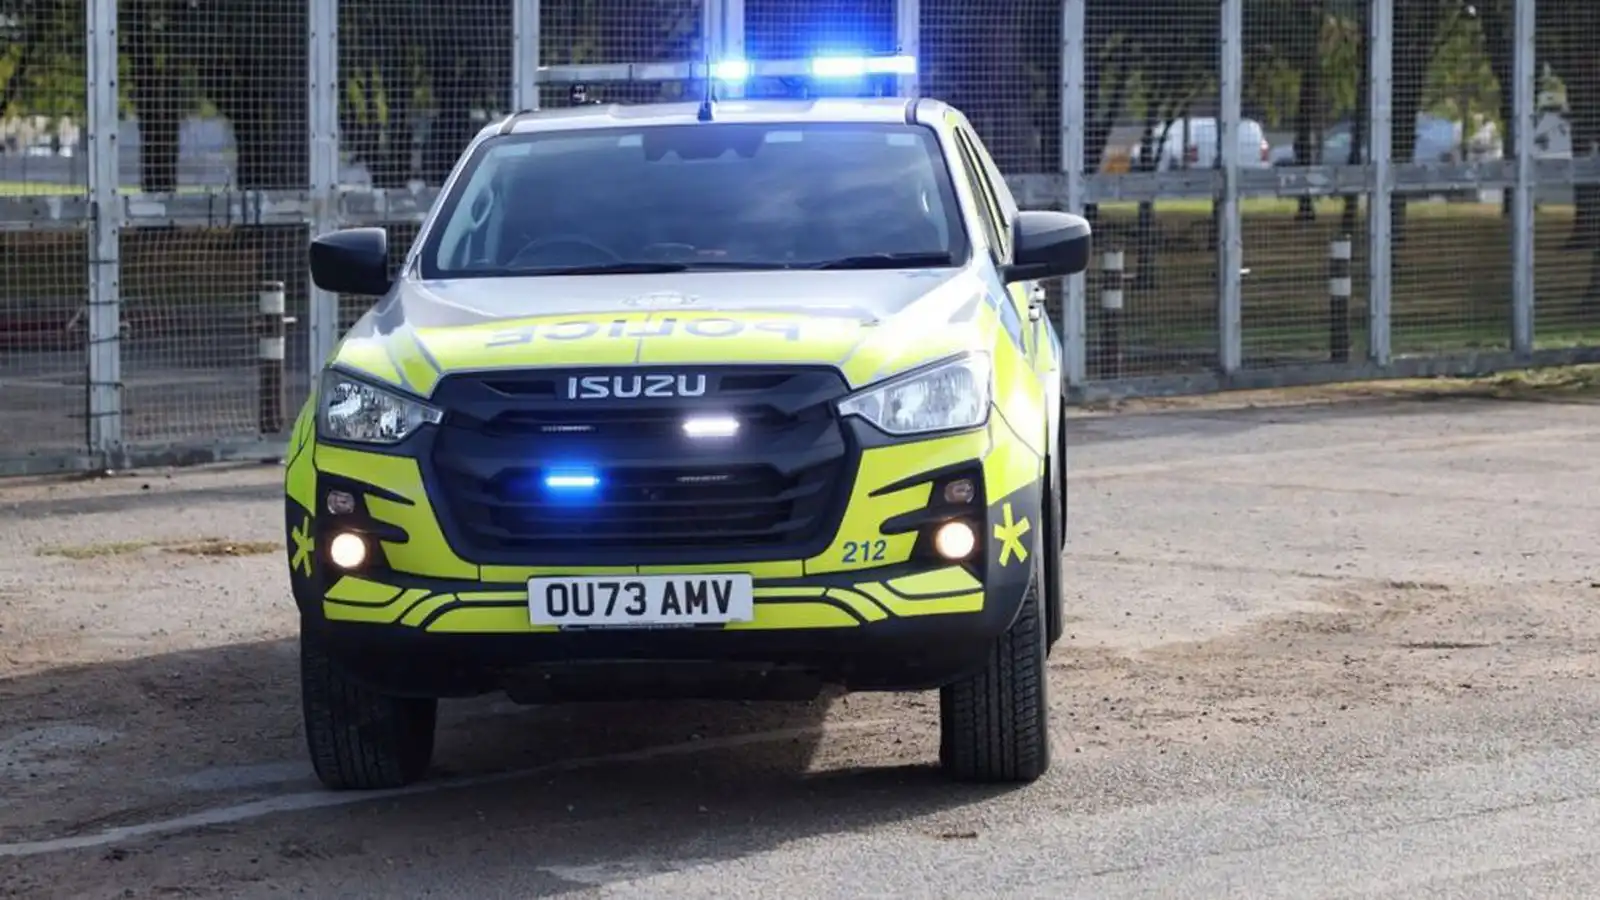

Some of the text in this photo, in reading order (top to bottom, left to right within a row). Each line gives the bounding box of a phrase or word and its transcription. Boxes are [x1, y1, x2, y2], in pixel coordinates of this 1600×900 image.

[567, 374, 707, 400] ISUZU
[842, 540, 888, 563] 212
[545, 580, 733, 617] OU73 AMV
